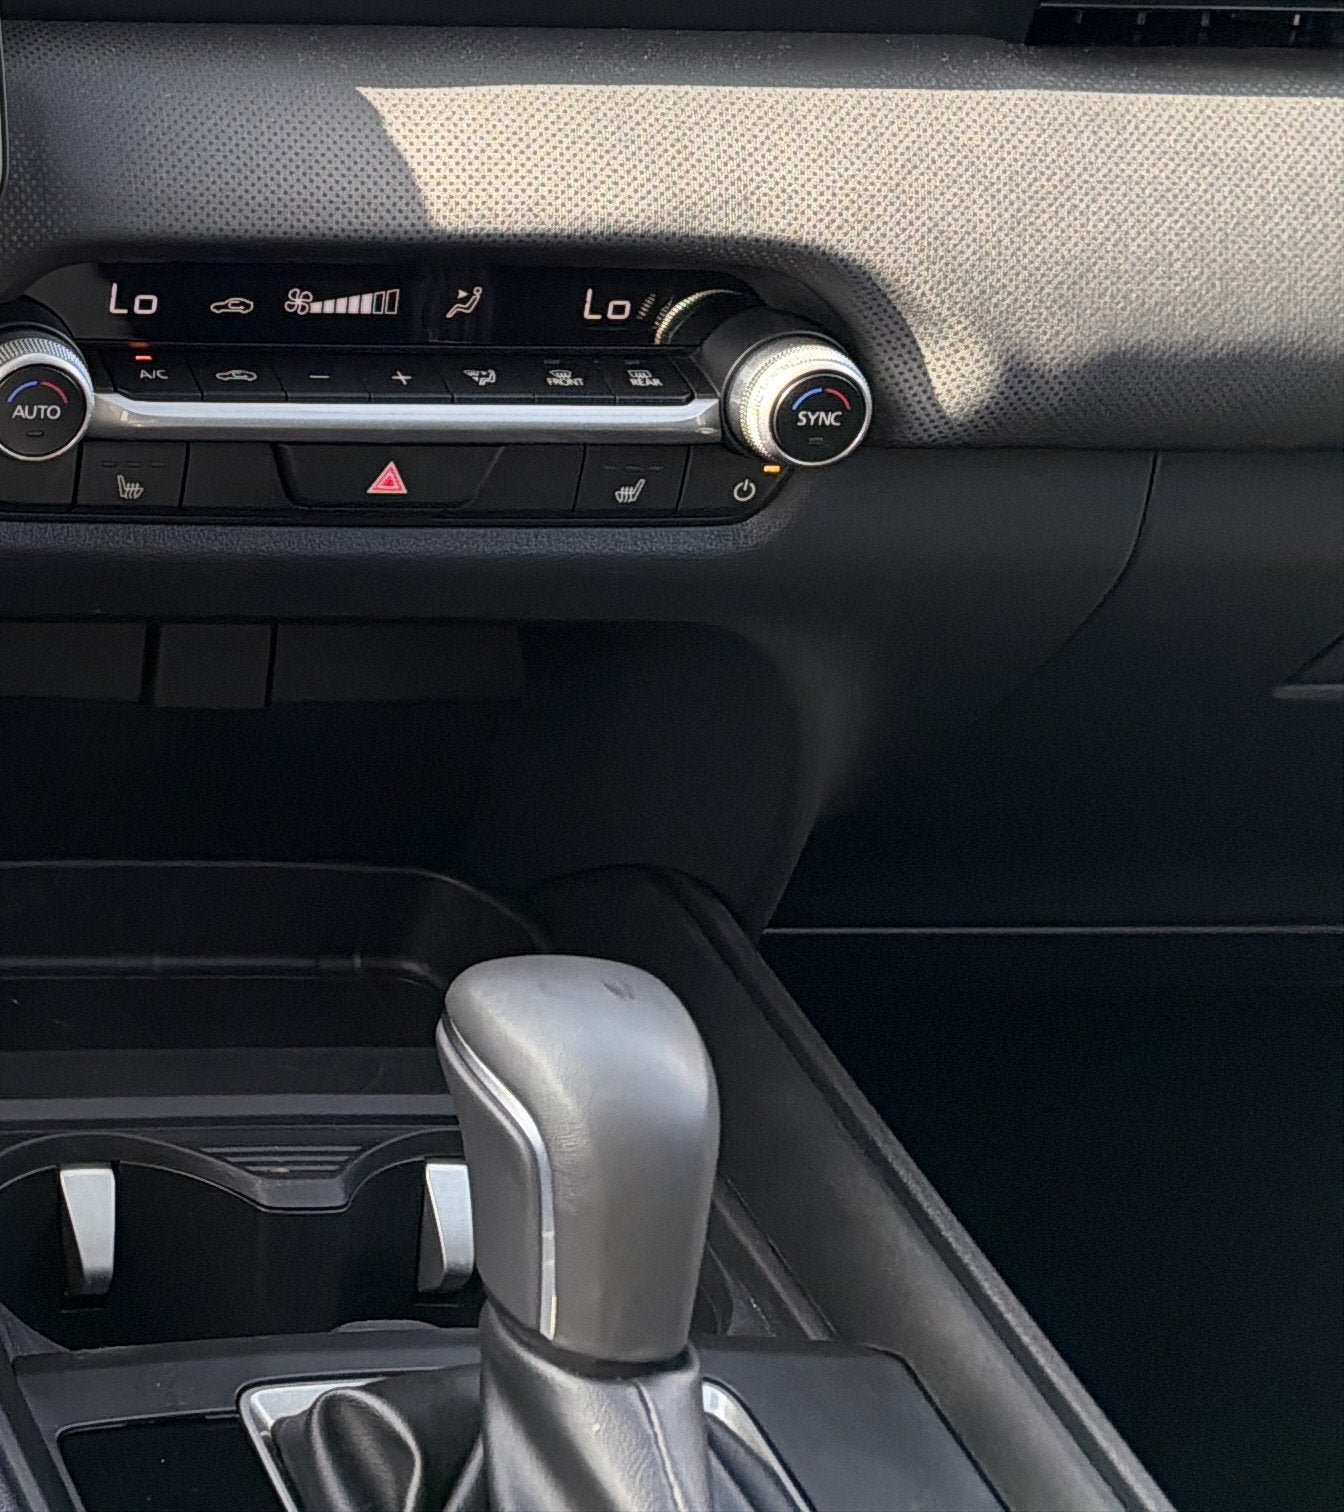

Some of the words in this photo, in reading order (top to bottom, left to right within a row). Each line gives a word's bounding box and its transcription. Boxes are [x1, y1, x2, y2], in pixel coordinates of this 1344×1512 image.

[139, 369, 169, 381] A/C
[546, 375, 584, 388] FRONT
[629, 374, 663, 388] REAR
[12, 403, 61, 420] AUTO
[796, 410, 843, 428] SYNC
